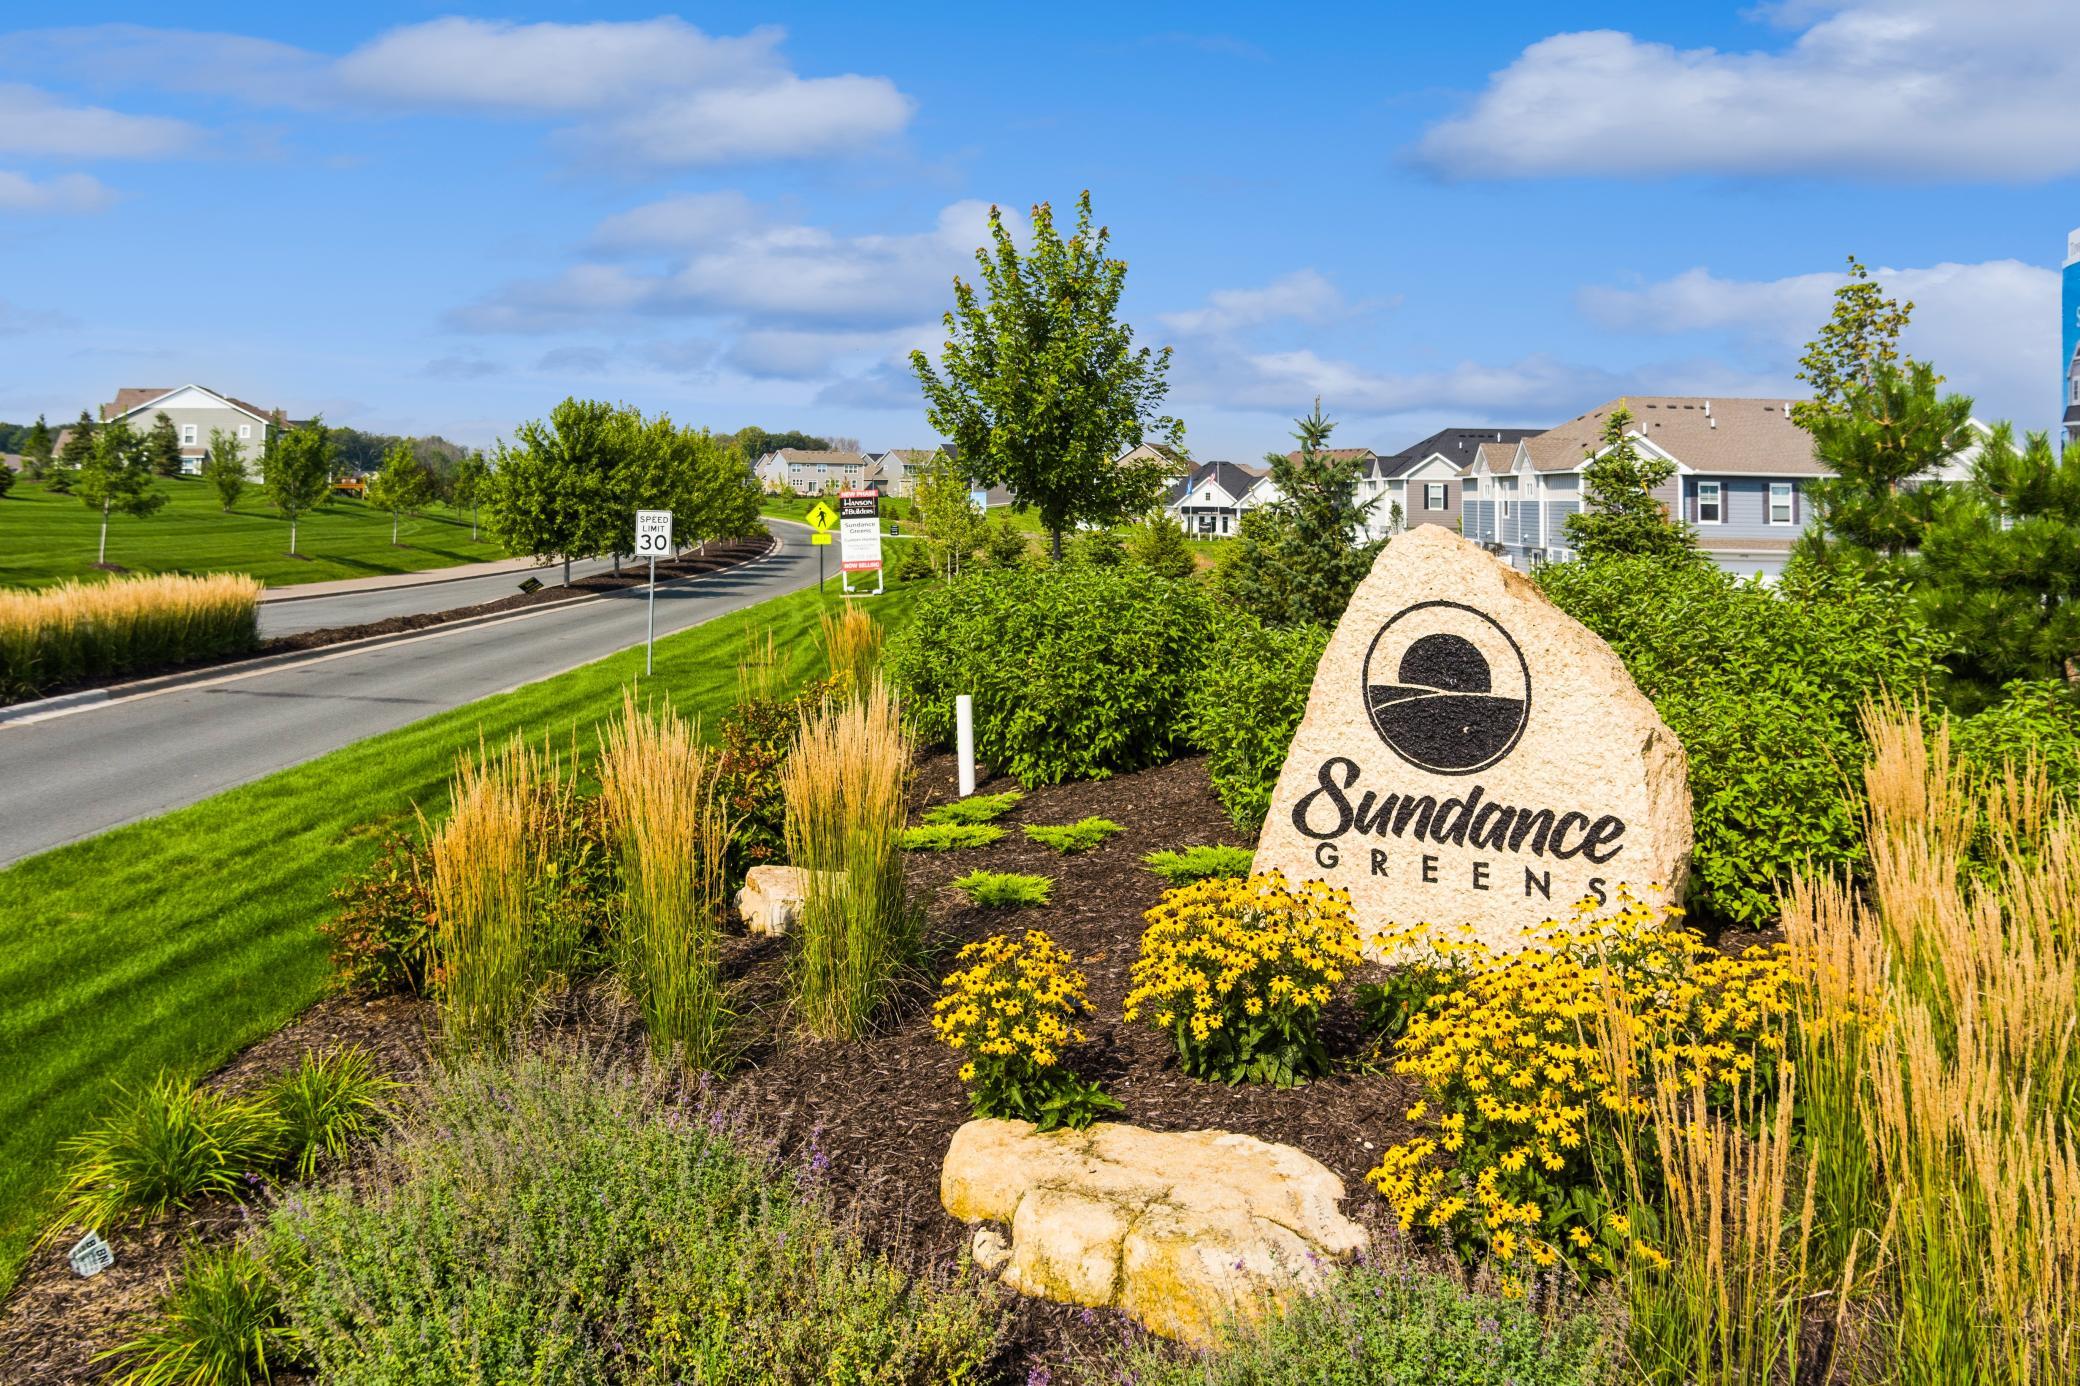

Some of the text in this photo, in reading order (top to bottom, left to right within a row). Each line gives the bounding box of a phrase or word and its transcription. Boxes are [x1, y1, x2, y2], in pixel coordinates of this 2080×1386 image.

[640, 534, 667, 551] 30
[642, 525, 665, 533] LIMIT
[1291, 756, 1626, 864] Sundance
[1315, 841, 1608, 907] GREENS
